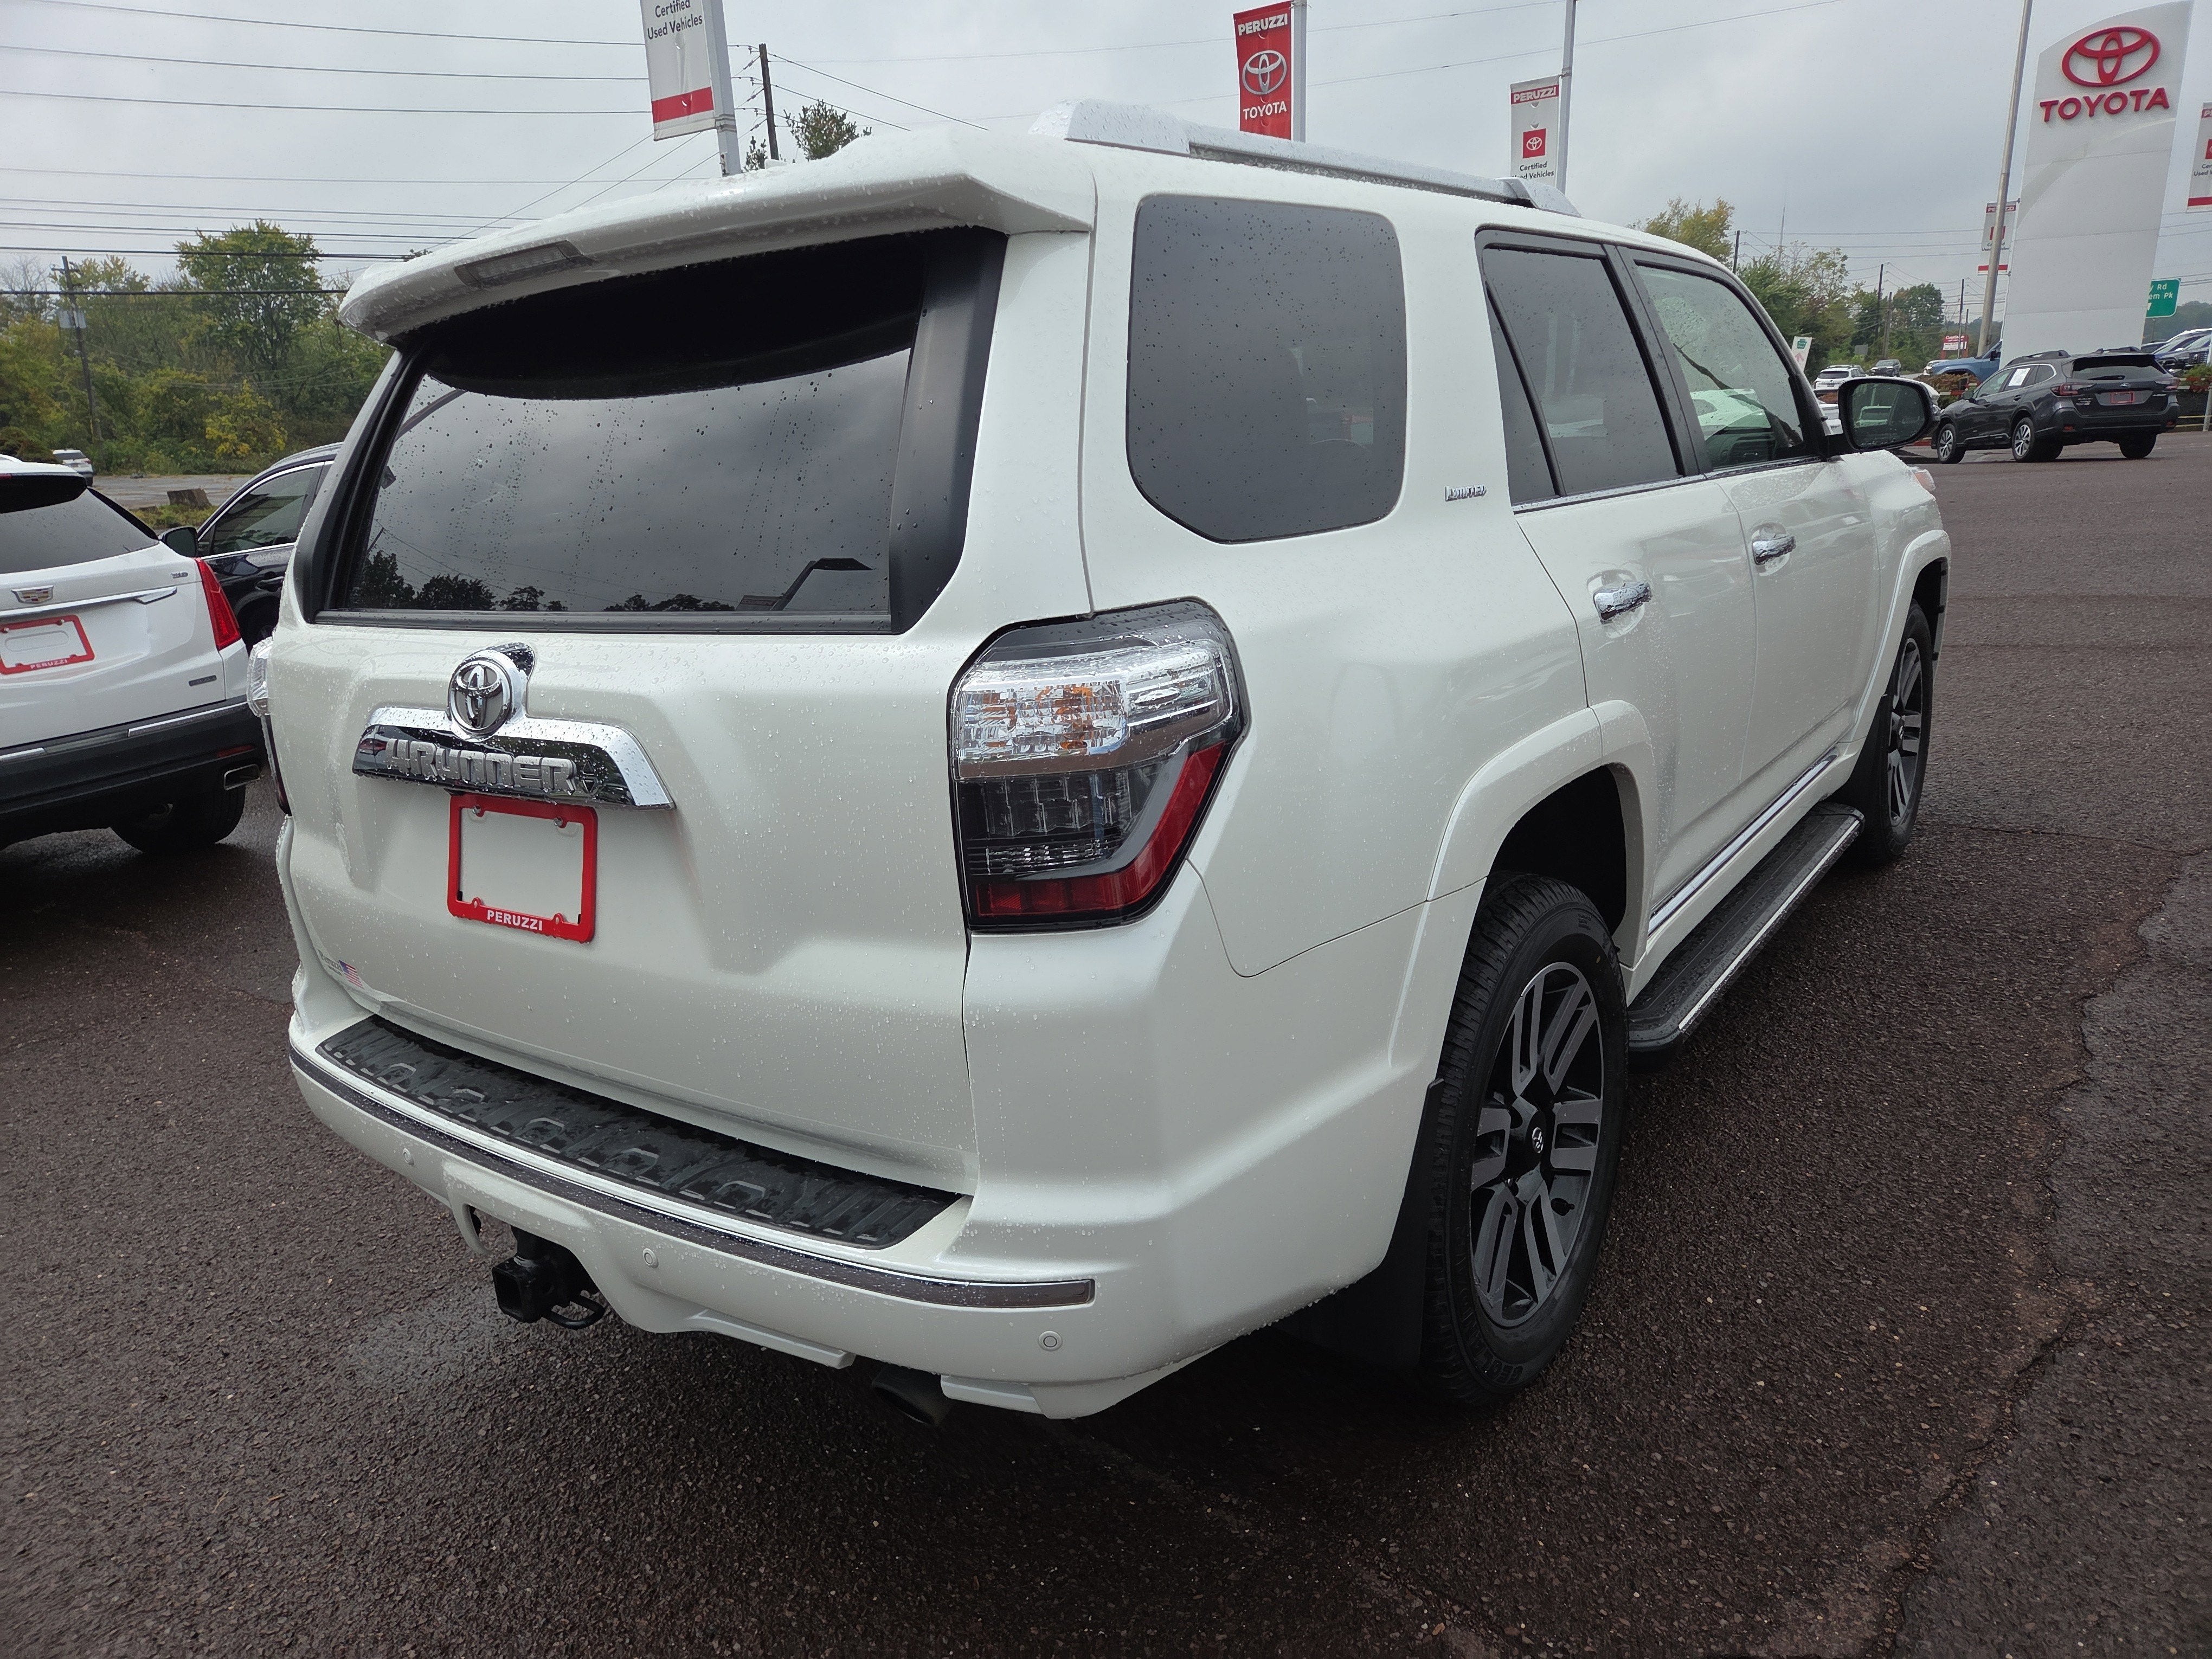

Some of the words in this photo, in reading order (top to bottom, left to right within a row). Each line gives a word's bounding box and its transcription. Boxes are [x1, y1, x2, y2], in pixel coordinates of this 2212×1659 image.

[654, 0, 691, 18] Certified
[647, 22, 668, 40] Used
[668, 14, 703, 34] Vehicles
[1238, 13, 1288, 36] PERUZZI
[1513, 87, 1557, 103] PERUZZI
[1243, 101, 1288, 120] TOYOTA
[2039, 87, 2170, 123] TOYOTA
[1520, 161, 1547, 171] Certified
[1529, 170, 1554, 179] Vehicles
[30, 659, 68, 670] PERUZZI
[384, 737, 577, 795] 4RUNNER
[487, 909, 543, 931] PERUZZI
